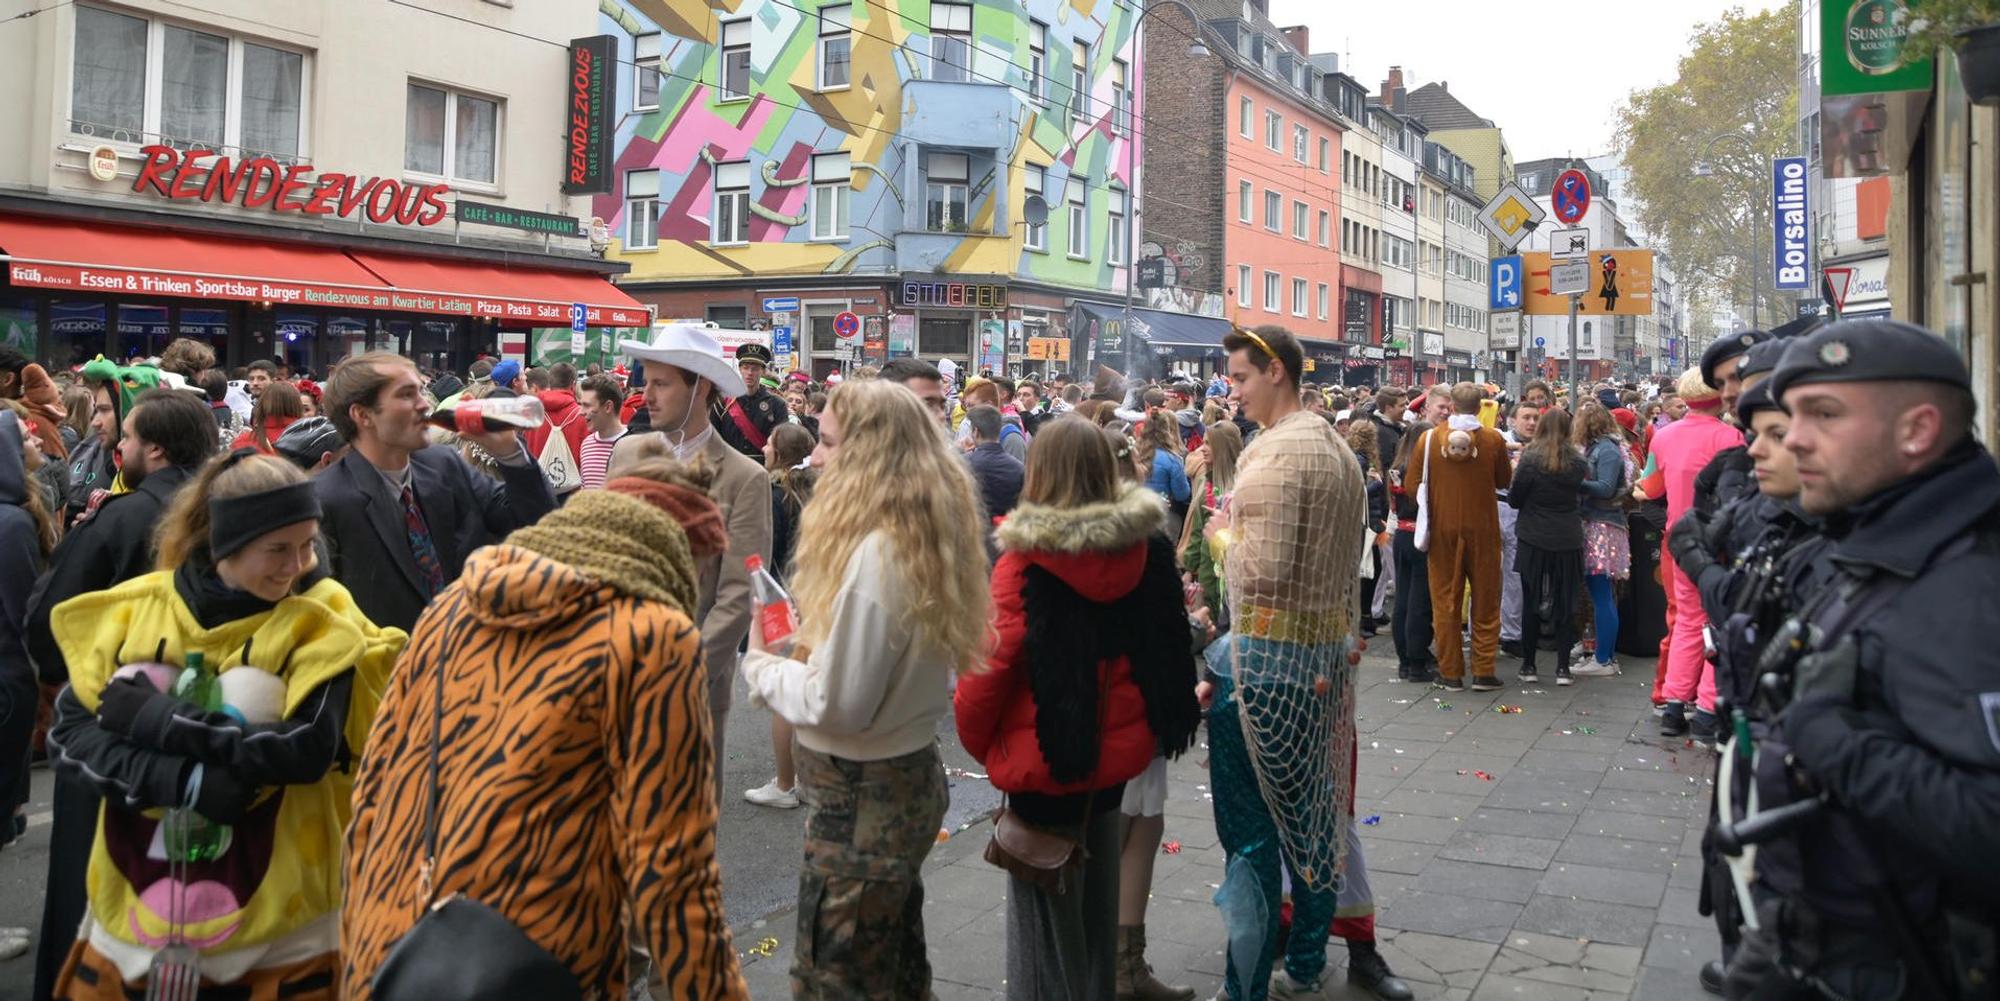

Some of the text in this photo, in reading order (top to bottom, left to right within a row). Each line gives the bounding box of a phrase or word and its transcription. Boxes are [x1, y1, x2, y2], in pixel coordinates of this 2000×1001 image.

[592, 56, 601, 117] RESTAURANT
[571, 47, 591, 185] RENDEZVOUS
[132, 145, 450, 226] RENDEZVOUS
[464, 207, 574, 233] CAFÉ BAR RESTAURANT
[1778, 163, 1806, 284] Borsalino
[80, 271, 123, 289] Essen
[125, 275, 138, 290] &
[140, 276, 191, 293] Trinken
[195, 279, 259, 297] Sportsbar
[262, 284, 301, 302] Burger
[304, 288, 369, 305] Rendezvous
[373, 296, 389, 306] am
[392, 295, 436, 310] Kwartier
[439, 298, 472, 315] Latäng
[477, 301, 502, 314] Pizza
[507, 303, 532, 316] Pasta
[538, 305, 560, 317] Salat
[567, 307, 601, 320] Ctail
[903, 281, 1008, 309] STIEFEL
[1497, 264, 1514, 302] P
[574, 306, 583, 329] P
